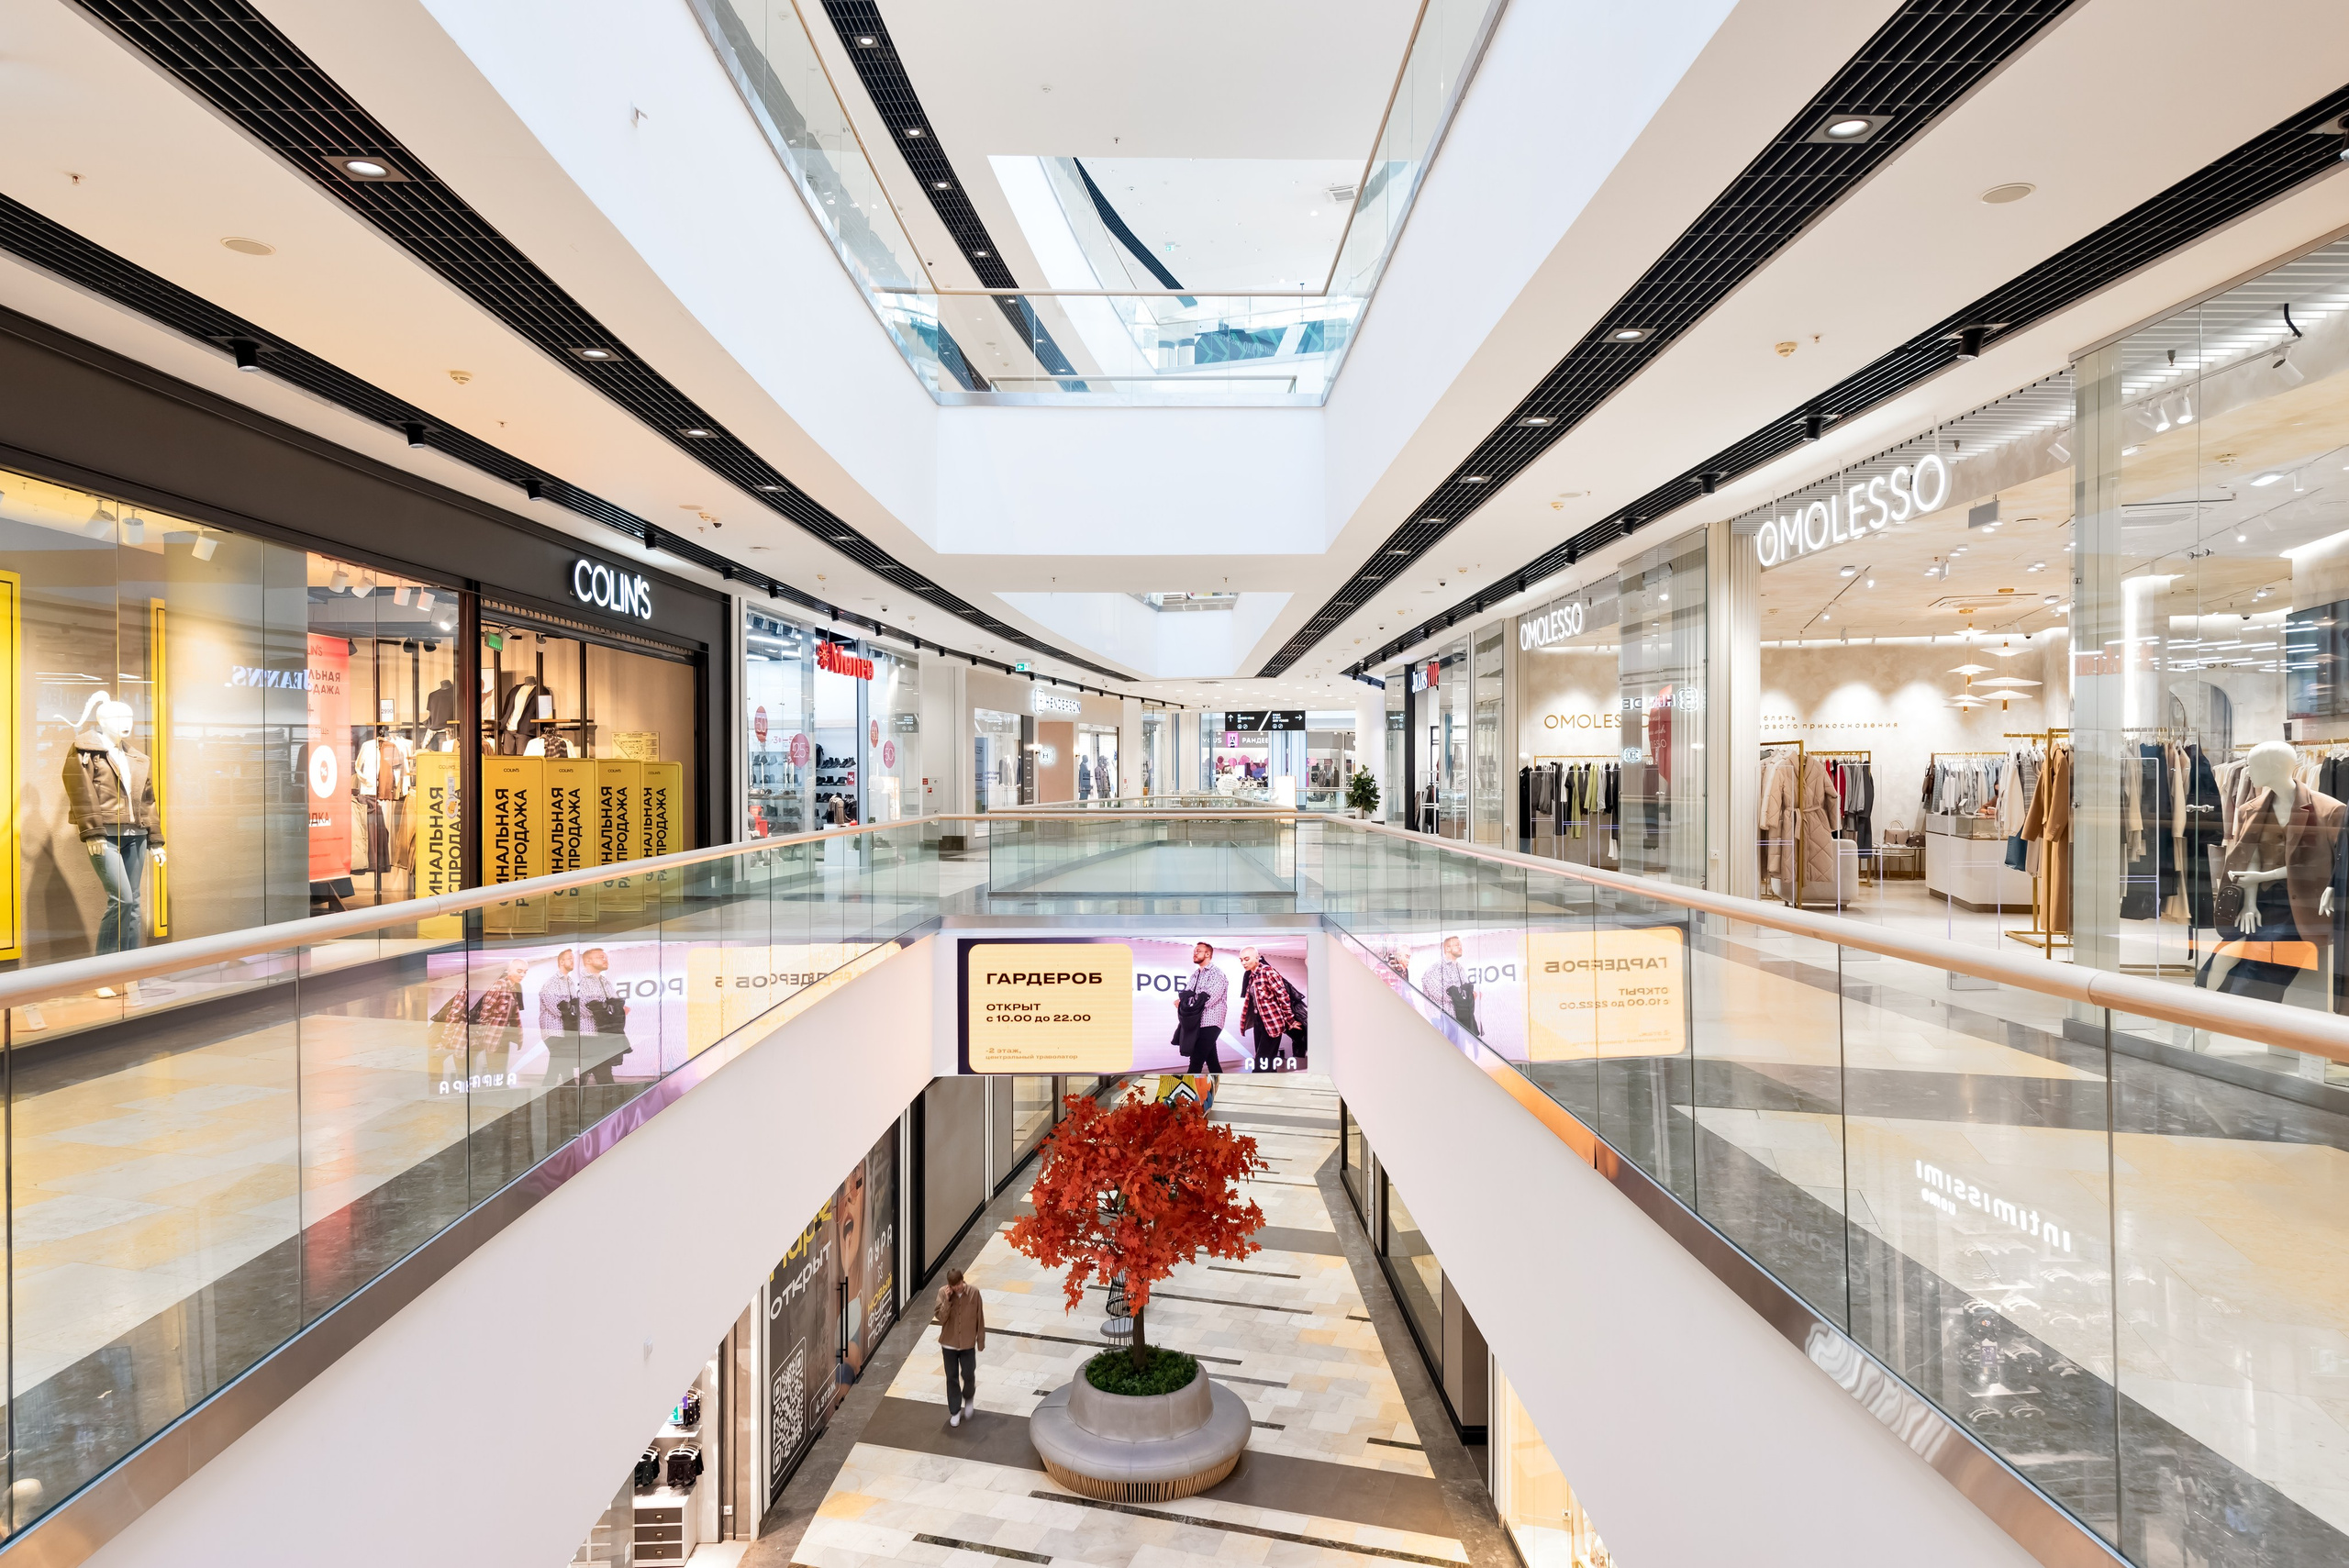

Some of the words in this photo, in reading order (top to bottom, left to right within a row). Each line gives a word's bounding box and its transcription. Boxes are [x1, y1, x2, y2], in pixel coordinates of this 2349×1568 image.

[1757, 454, 1945, 567] OMOLESSO
[574, 559, 651, 620] COLIN'S
[1520, 602, 1583, 651] OMOLESSO
[828, 642, 874, 681] Monro
[1046, 696, 1081, 714] HENDERSON
[1803, 722, 1898, 730] прикосновения
[429, 787, 444, 897] ИНАЛЬНАЯ
[985, 972, 1103, 986] ГАРДЕРОБ
[1133, 973, 1188, 993] РОБ
[985, 1003, 1041, 1012] ОТКРЫТ
[996, 1014, 1032, 1023] 10.00
[1034, 1015, 1051, 1024] до
[1052, 1014, 1092, 1022] 22.00
[1244, 1056, 1297, 1071] АУРА
[867, 1223, 893, 1273] АУРА
